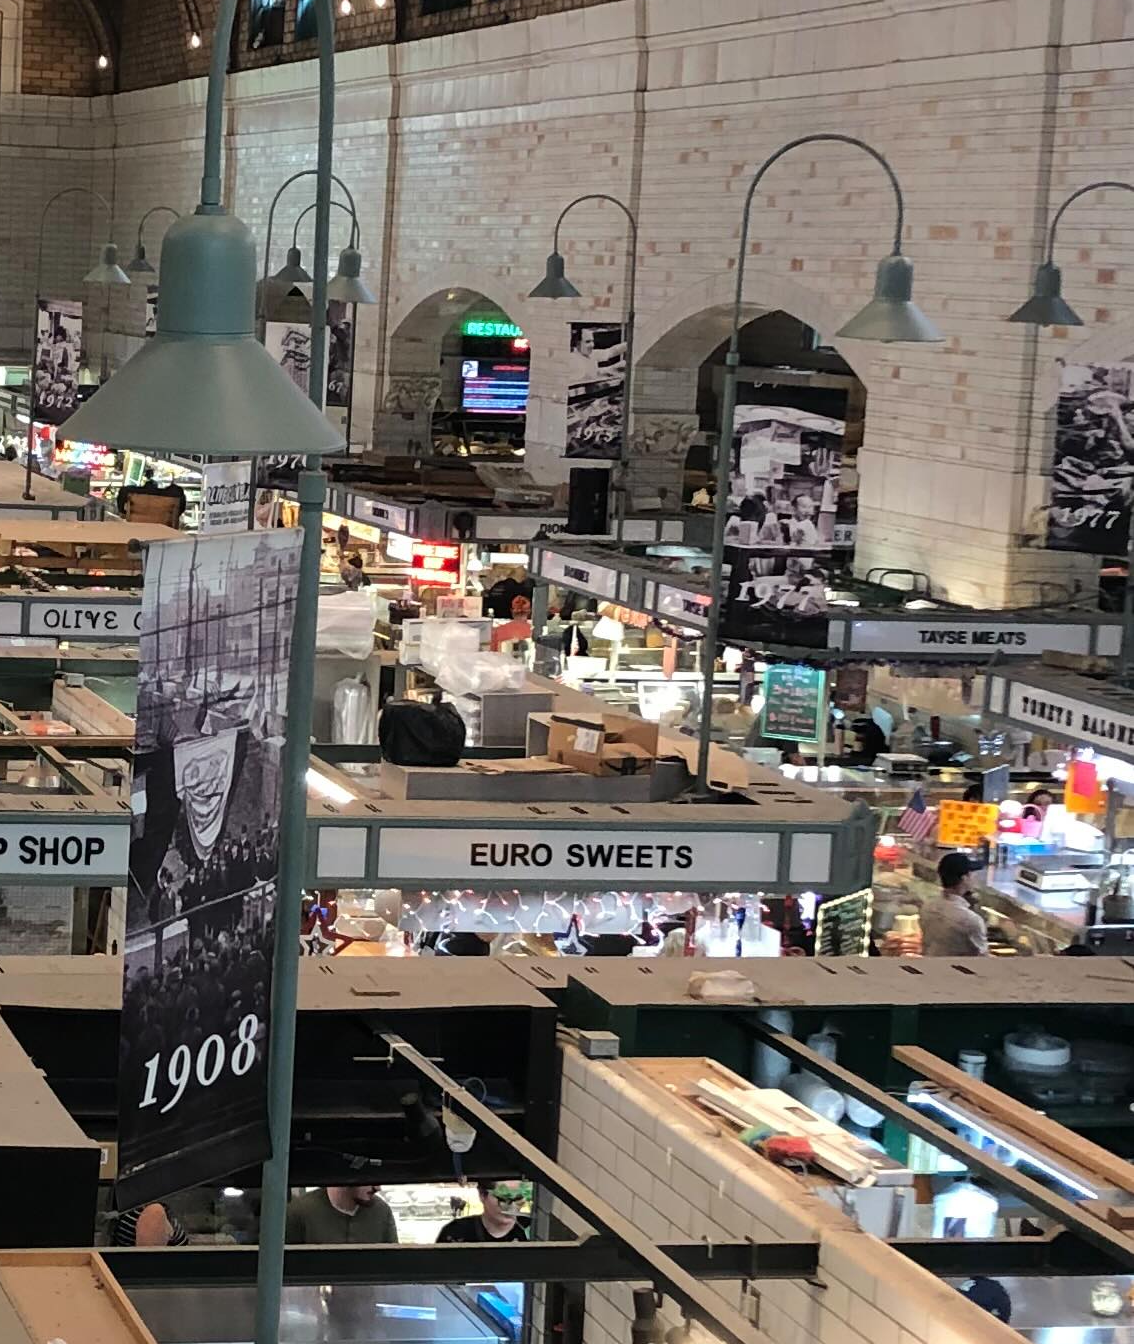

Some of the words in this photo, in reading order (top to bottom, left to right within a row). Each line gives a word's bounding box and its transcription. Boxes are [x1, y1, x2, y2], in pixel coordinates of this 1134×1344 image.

[38, 394, 73, 408] 1972
[539, 523, 568, 535] DION
[1061, 506, 1121, 531] 1977
[43, 609, 118, 630] OLIVE
[918, 630, 967, 645] TAYSE
[971, 631, 1027, 646] MEATS
[19, 836, 106, 866] SHOP
[470, 842, 553, 867] EURO
[566, 843, 694, 869] SWEETS
[138, 1012, 260, 1114] 1908
